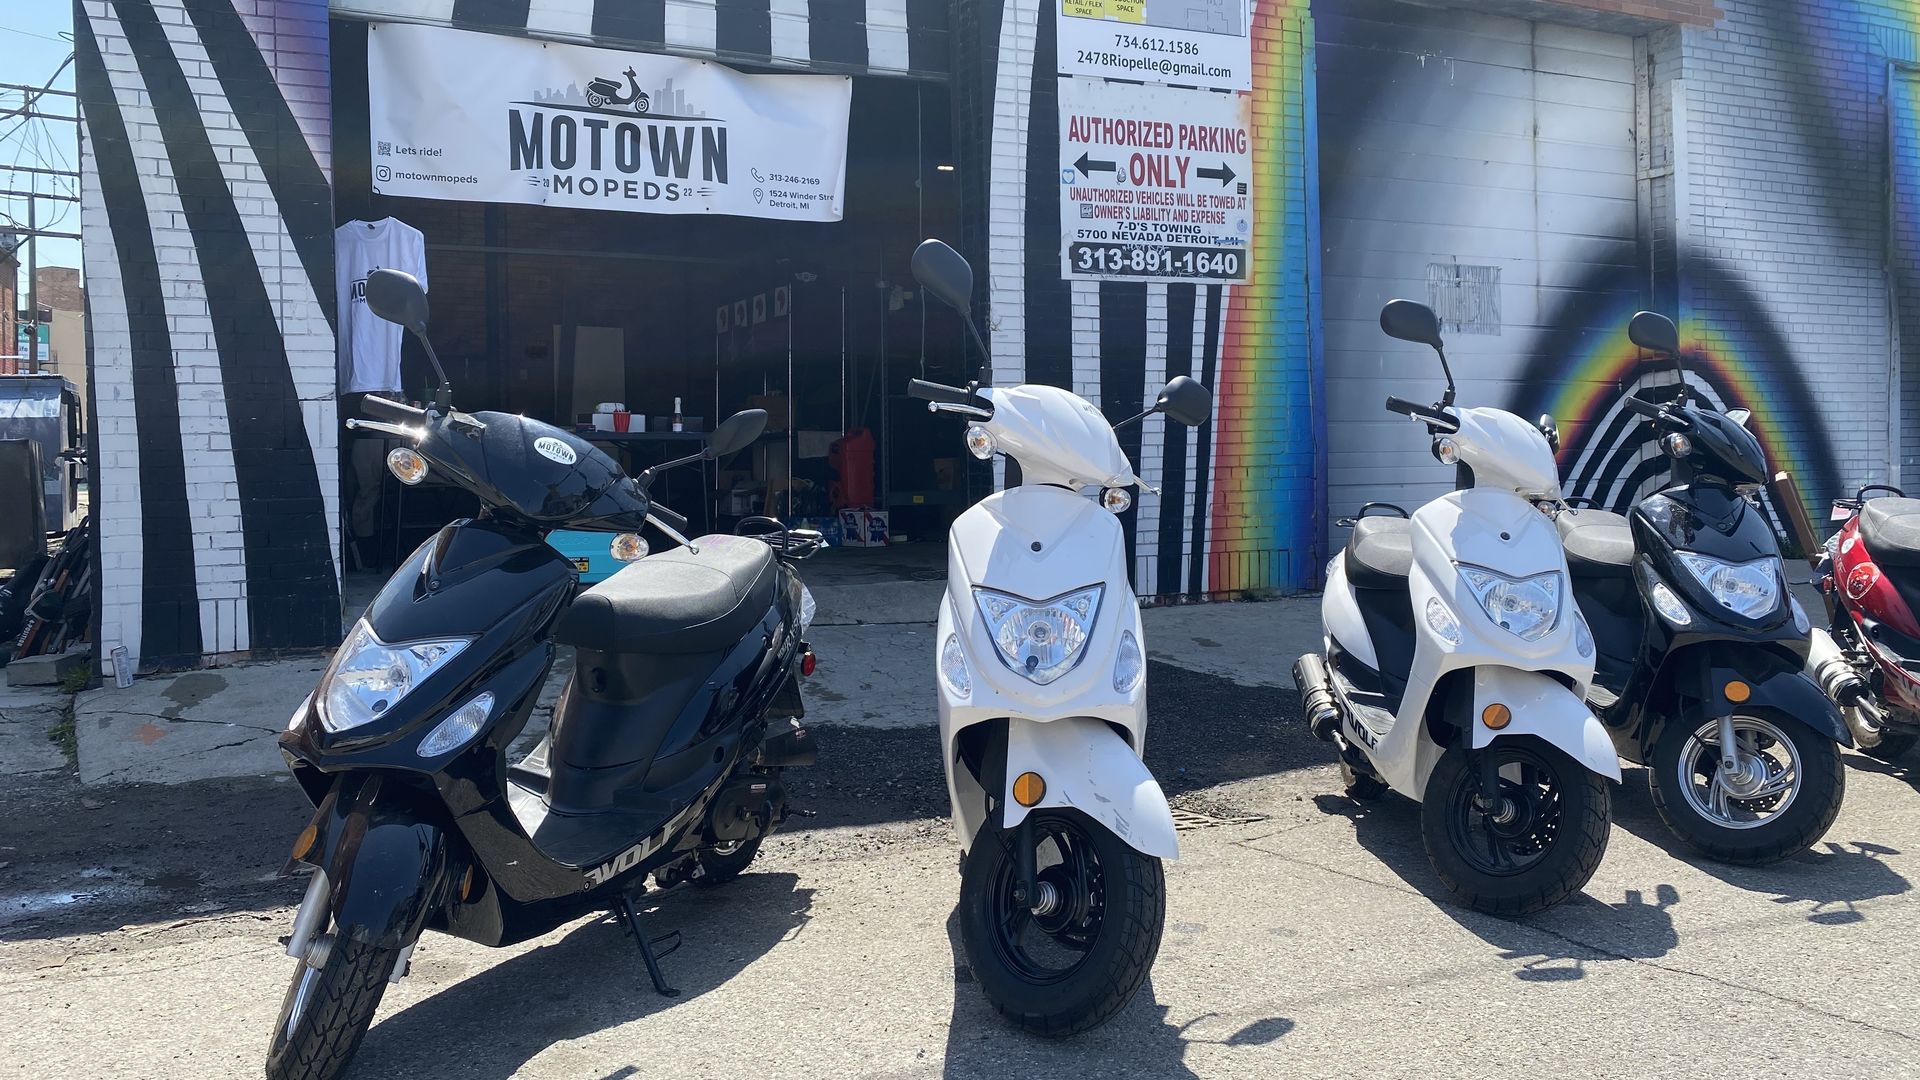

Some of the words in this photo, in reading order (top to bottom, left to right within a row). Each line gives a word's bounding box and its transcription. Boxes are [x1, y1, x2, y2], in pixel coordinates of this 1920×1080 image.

[1116, 5, 1134, 13] SPACE
[1114, 34, 1199, 56] 734.612.1586
[1077, 50, 1232, 78] 2478Riopelle@gmail.com
[1068, 115, 1174, 149] AUTHORIZED
[1179, 124, 1247, 155] PARKING
[395, 145, 417, 155] Lets
[419, 147, 442, 157] ride!
[508, 109, 728, 185] MOTOWN
[395, 171, 478, 185] motownmopeds
[769, 173, 820, 185] 313-246-2169
[1129, 152, 1191, 189] ONLY
[553, 174, 680, 202] MOPEDS
[683, 187, 693, 197] 22
[769, 189, 788, 198] 1524
[789, 191, 817, 201] Winder
[1069, 187, 1134, 204] UNAUTHORIZED
[1136, 191, 1175, 206] VEHICLES
[1177, 193, 1195, 207] WILL
[1197, 194, 1207, 208] BE
[1209, 195, 1235, 210] TOWED
[1237, 197, 1247, 210] AT
[769, 199, 798, 210] Detroit,
[800, 202, 810, 210] MI
[1094, 204, 1131, 220] OWNER'S
[1132, 206, 1171, 222] LIABILITY
[1172, 209, 1189, 223] AND
[1191, 210, 1226, 225] EXPENSE
[1077, 229, 1108, 240] 5700
[1111, 231, 1163, 243] NEVADA
[1117, 221, 1148, 232] 7-D'S
[1152, 223, 1201, 234] TOWING
[1078, 247, 1238, 275] 313-891-1640
[537, 441, 574, 462] MOTOWN
[1341, 700, 1378, 750] WOLF
[584, 803, 692, 885] WOLF
